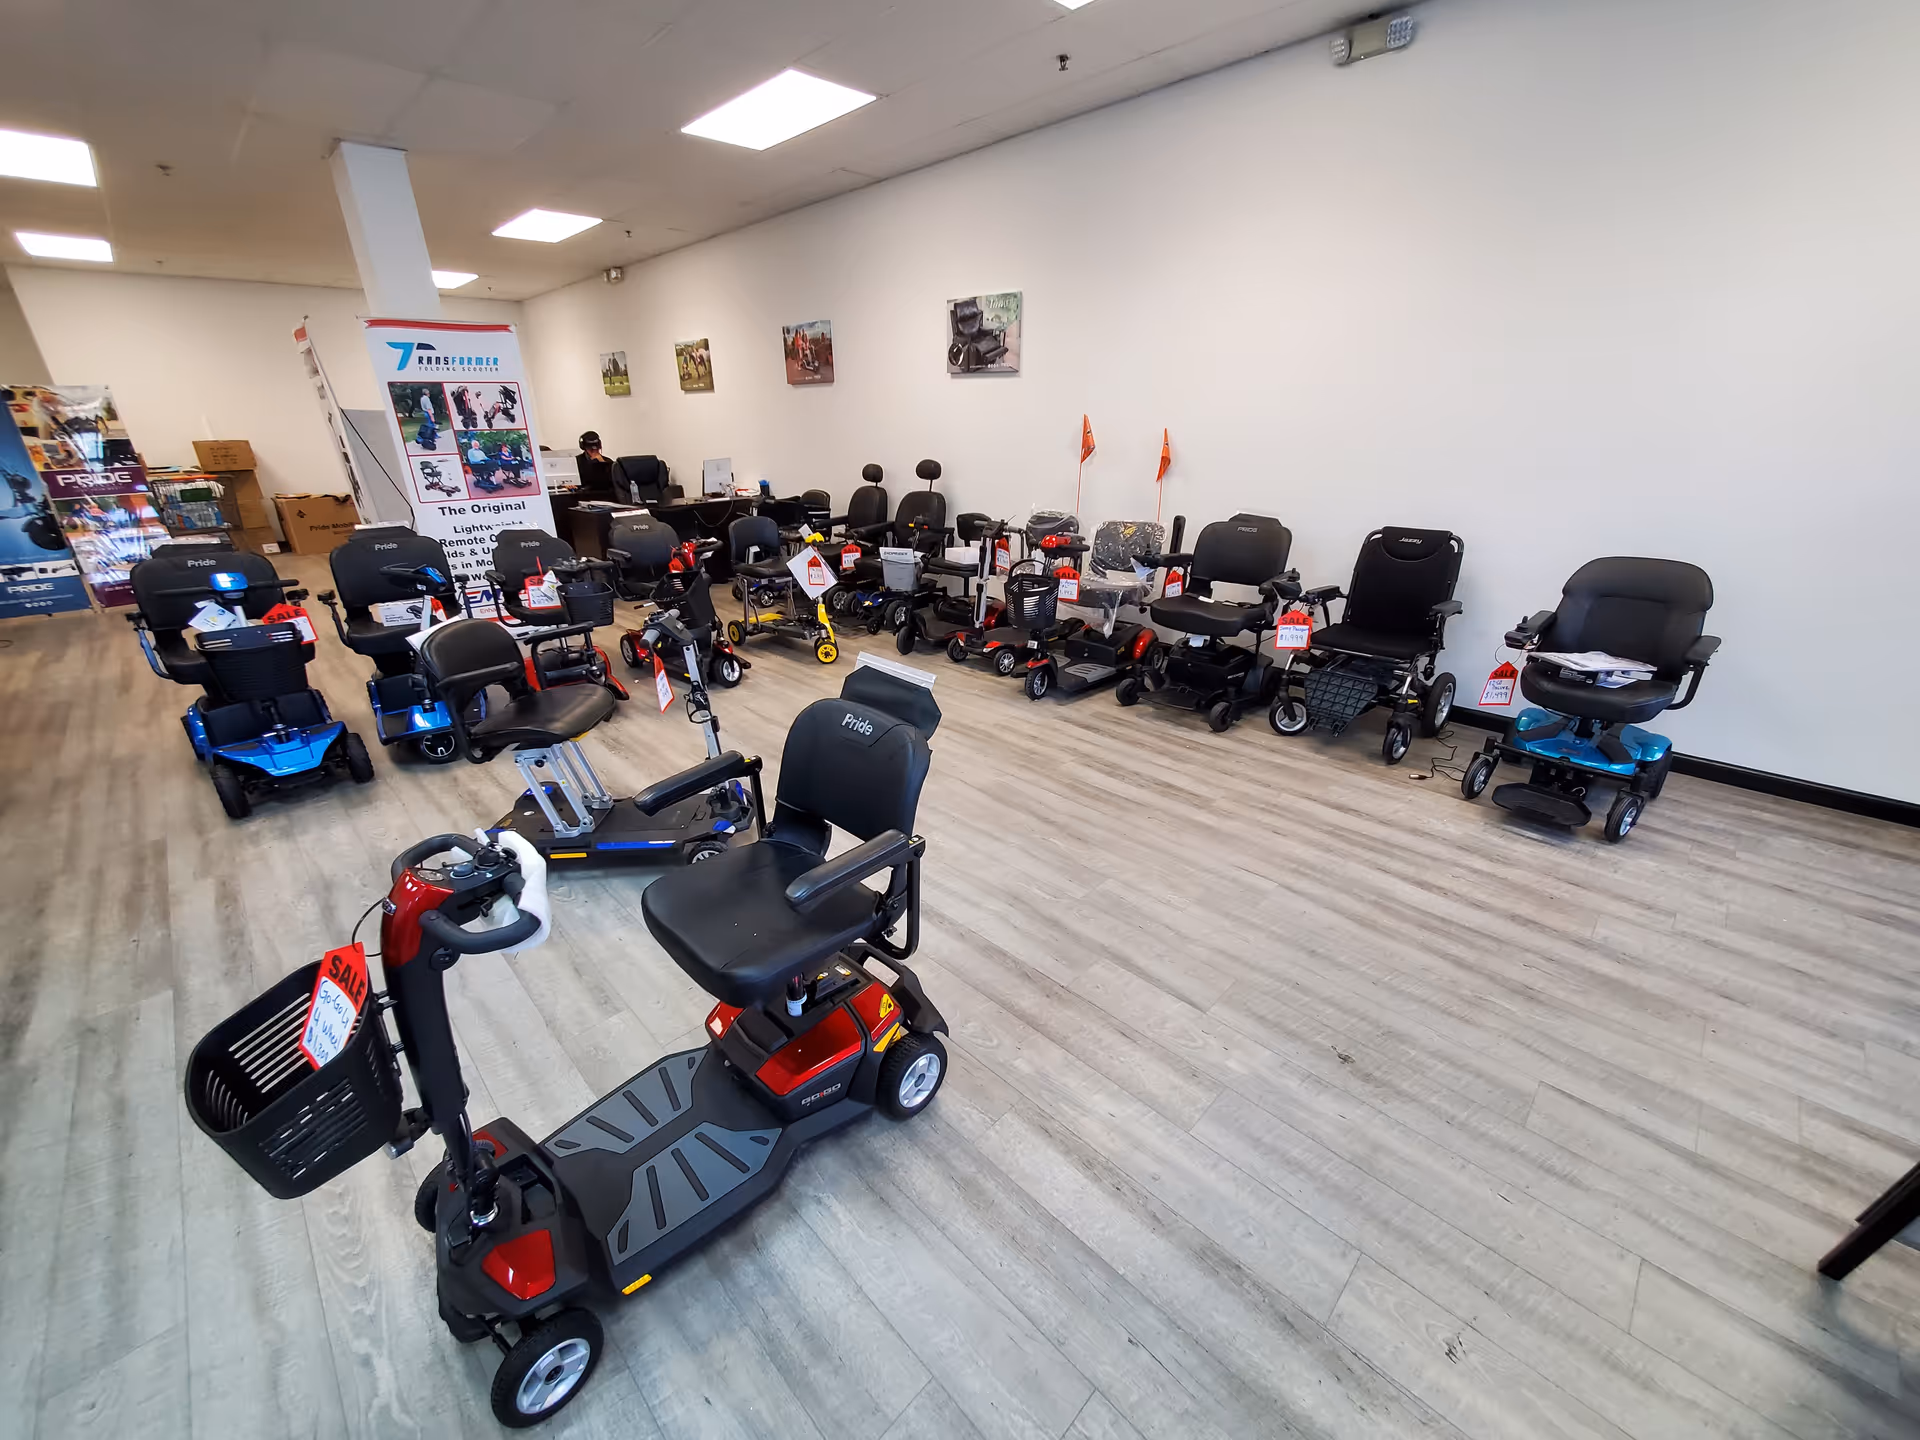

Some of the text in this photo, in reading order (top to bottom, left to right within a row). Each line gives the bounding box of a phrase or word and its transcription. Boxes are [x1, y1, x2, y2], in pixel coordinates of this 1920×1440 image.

[56, 471, 133, 487] PRIDE
[438, 500, 527, 516] The Original
[439, 535, 487, 548] Remote
[520, 540, 541, 549] Pride
[1398, 536, 1424, 545] Jazzy
[374, 542, 399, 551] Pride
[187, 558, 217, 568] Pride
[461, 561, 473, 570] in
[1055, 571, 1078, 579] SALE
[528, 577, 544, 586] SA
[7, 582, 56, 595] PRIDE
[267, 607, 304, 624] SALE
[1281, 616, 1310, 625] SALE
[1493, 669, 1517, 678] SALE
[841, 713, 874, 736] Pride
[328, 954, 367, 1006] SALE
